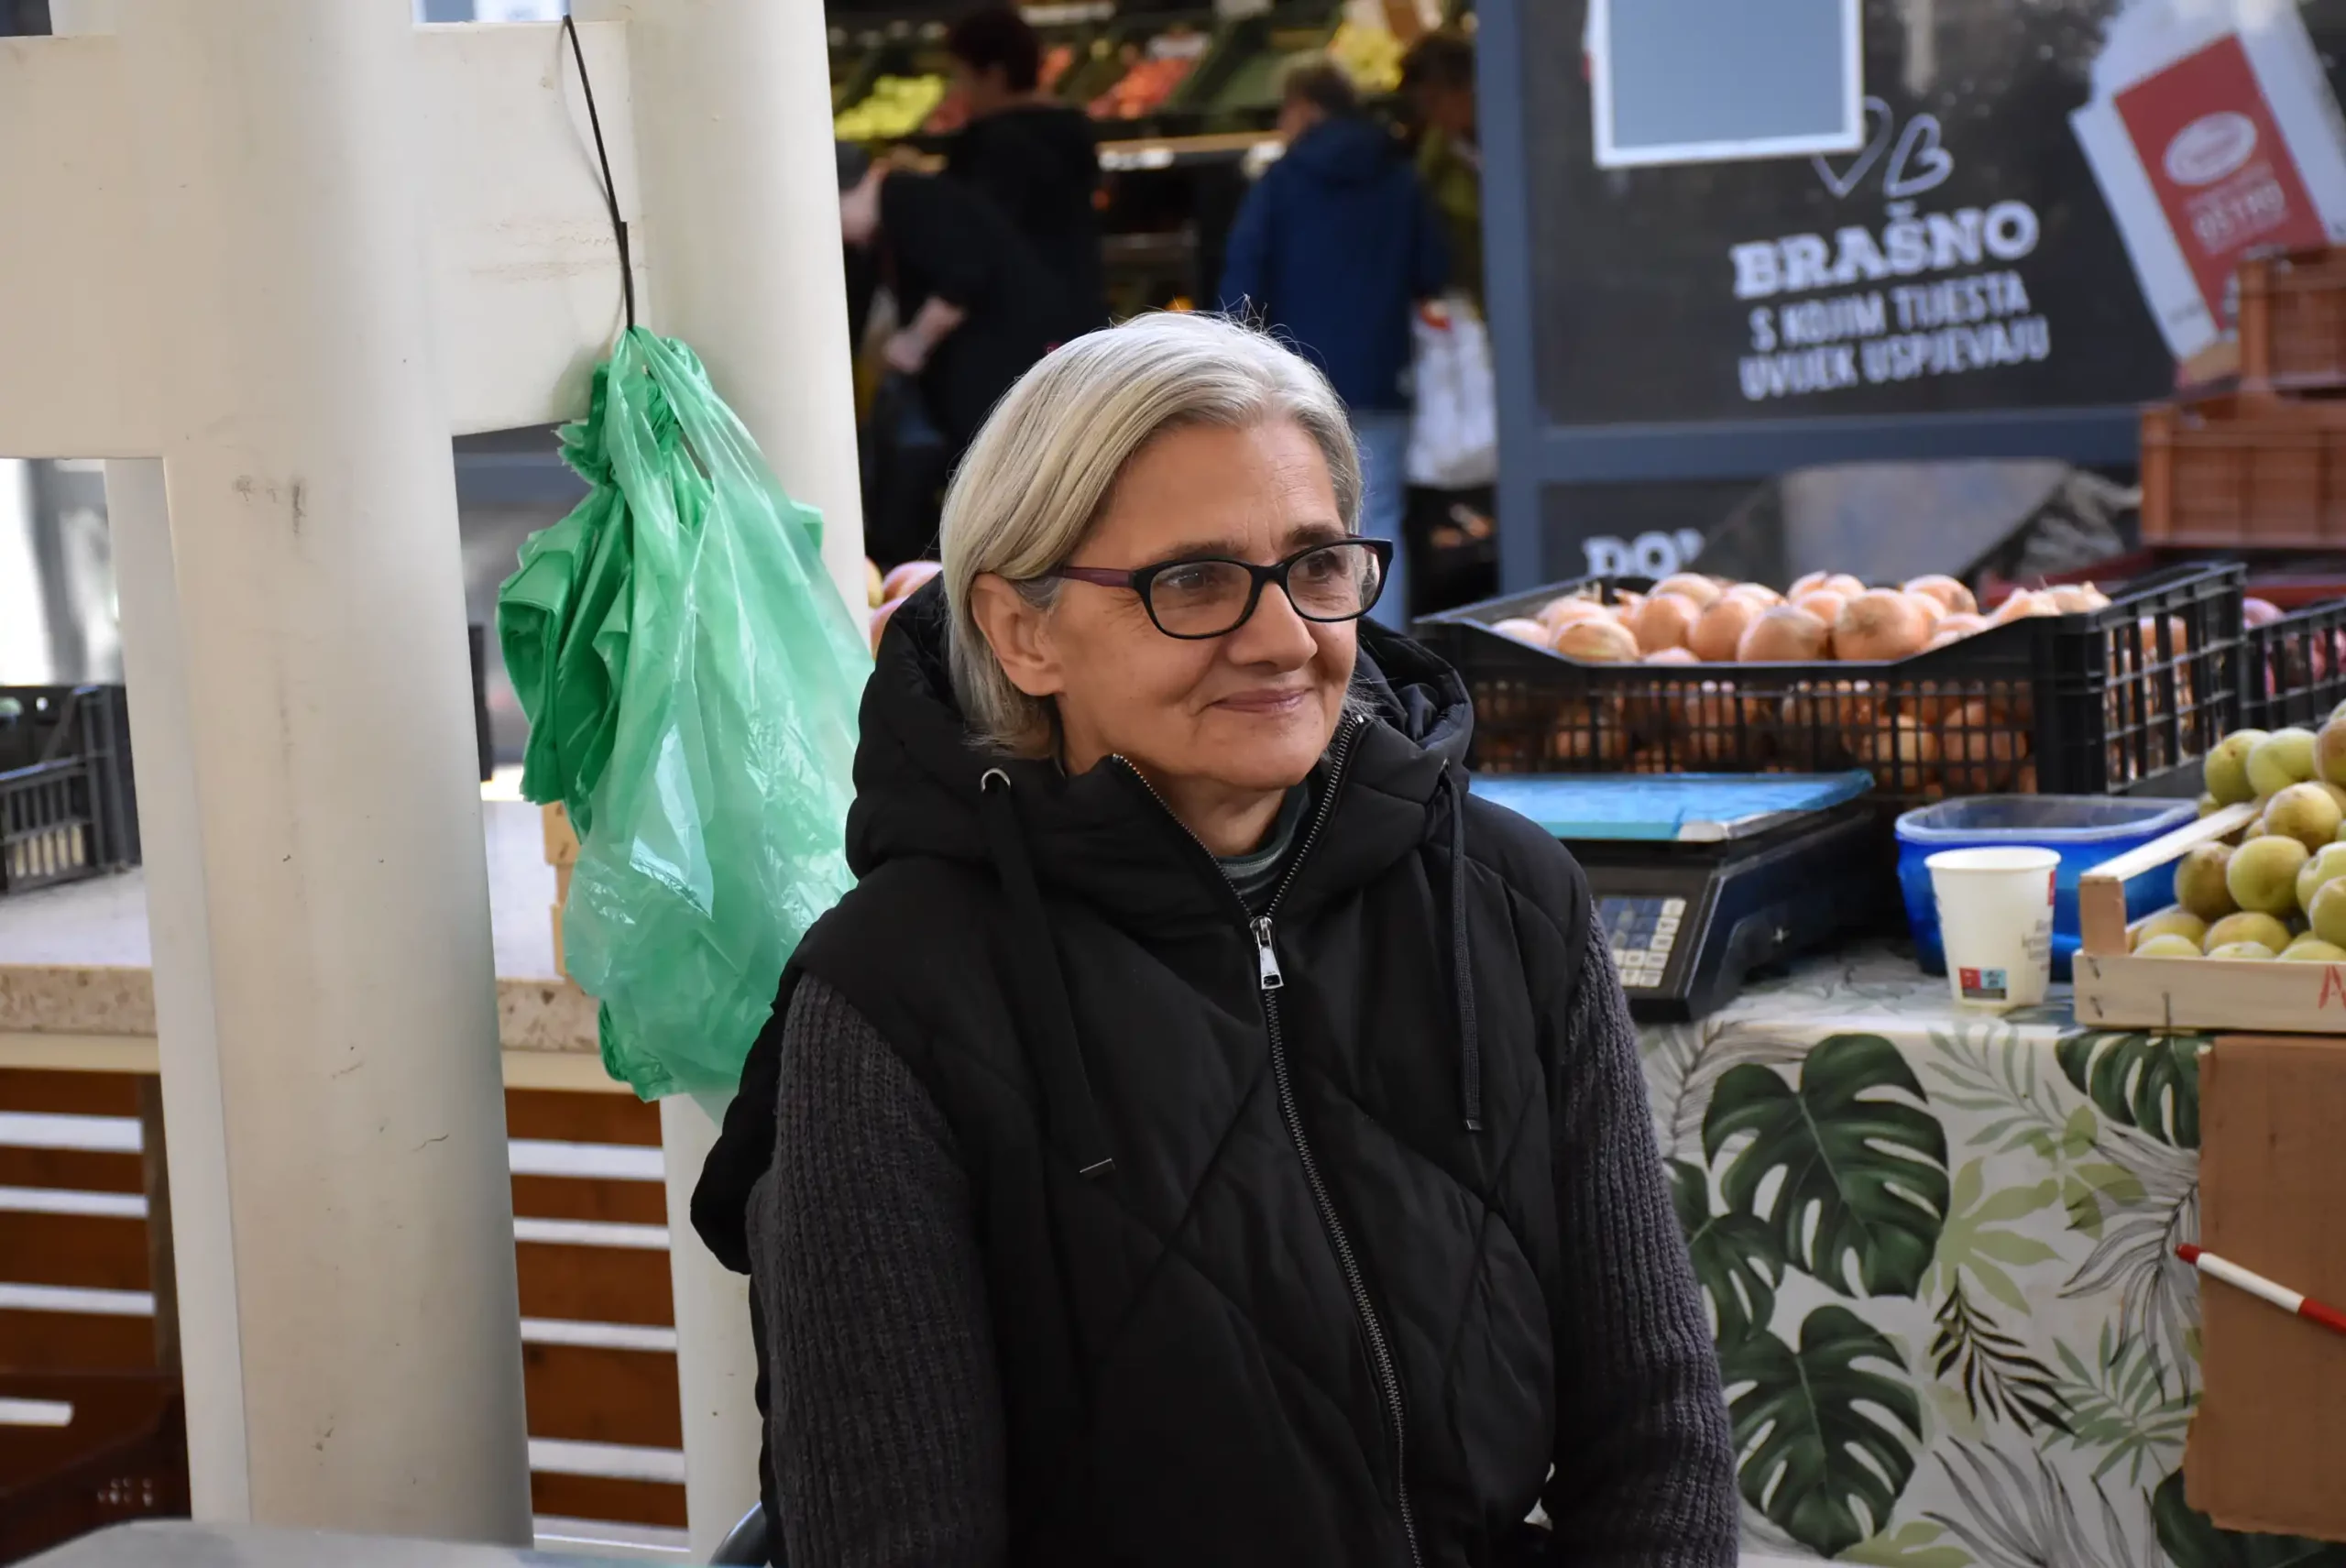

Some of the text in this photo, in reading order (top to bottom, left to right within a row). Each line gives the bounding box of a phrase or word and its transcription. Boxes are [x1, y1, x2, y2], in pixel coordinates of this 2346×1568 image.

[1730, 200, 2040, 300] BRAŠNO
[1749, 270, 2030, 352] S KOJIM TIJESTA
[1738, 314, 2050, 401] UVIJEK USPJEVAJU
